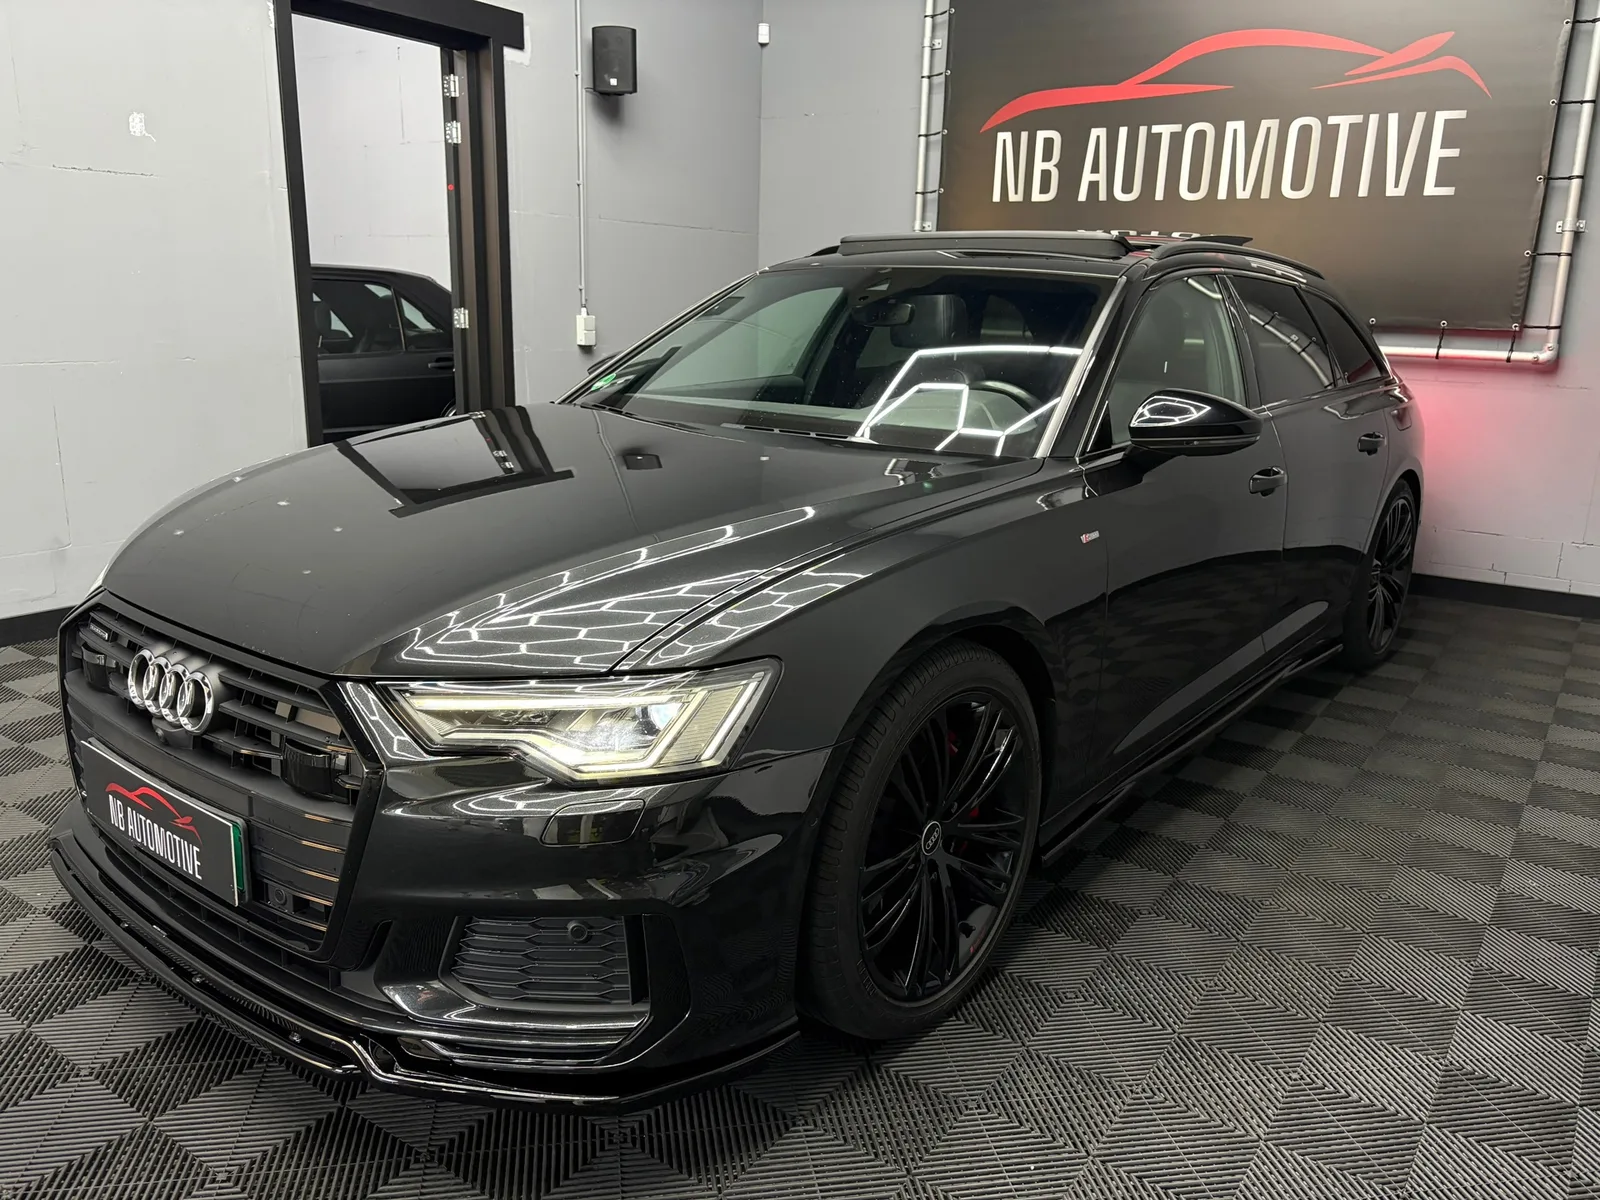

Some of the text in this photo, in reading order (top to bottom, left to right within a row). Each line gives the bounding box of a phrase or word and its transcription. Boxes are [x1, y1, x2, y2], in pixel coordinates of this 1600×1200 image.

[992, 109, 1468, 202] NB AUTOMOTIVE
[108, 794, 203, 881] NB AUTOMOTIVE
